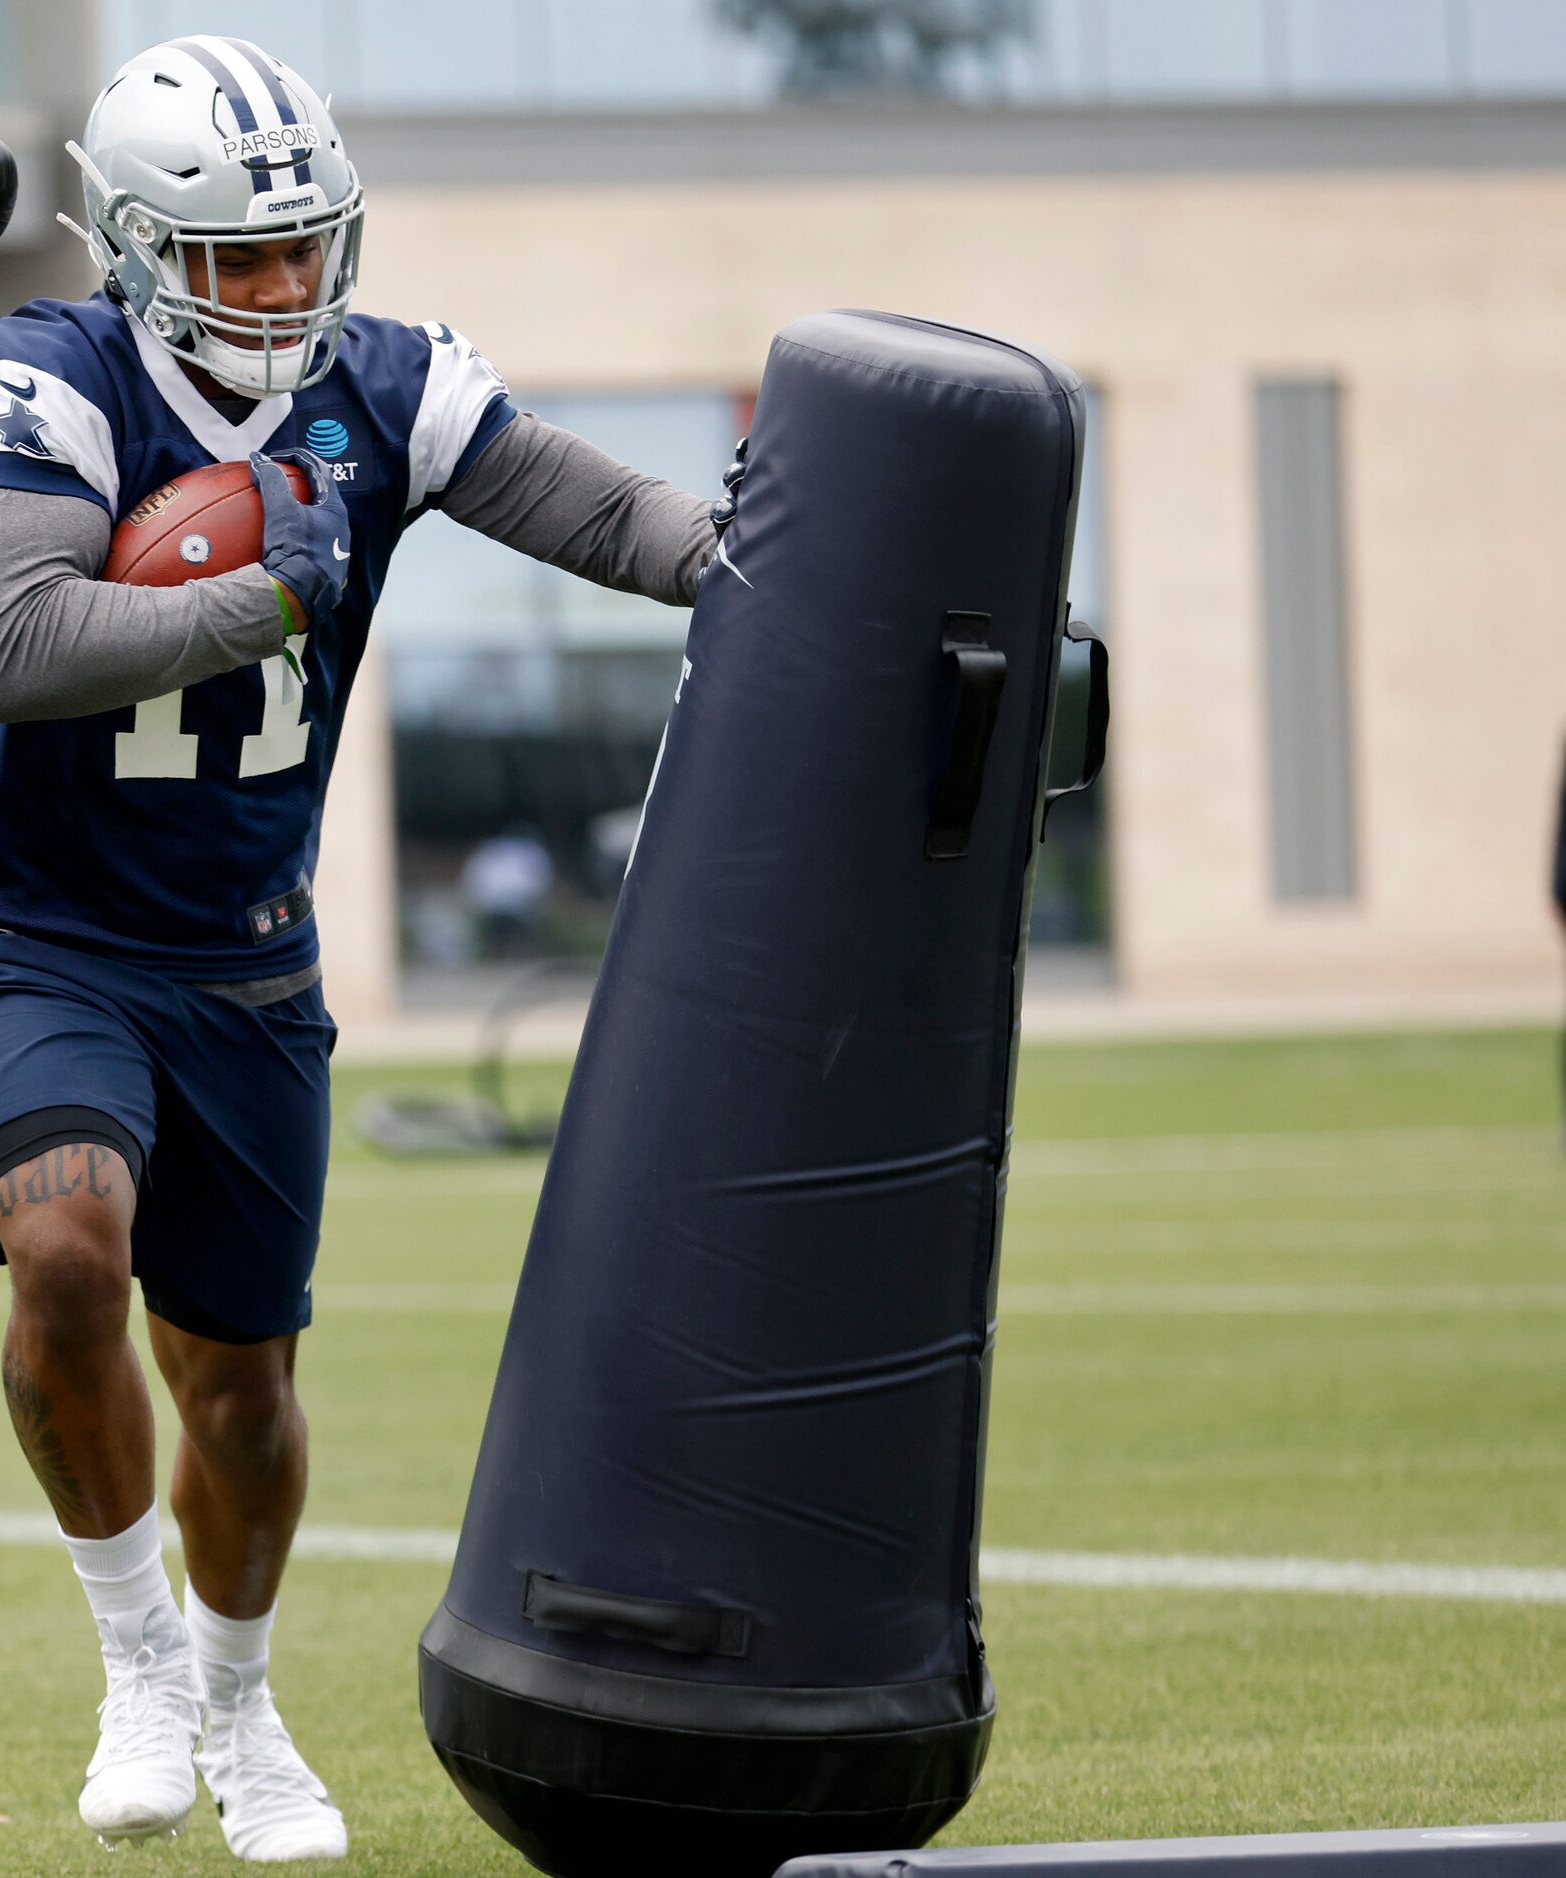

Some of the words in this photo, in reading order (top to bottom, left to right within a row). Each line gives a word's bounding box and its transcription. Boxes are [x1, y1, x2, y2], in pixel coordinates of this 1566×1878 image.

[223, 128, 317, 160] PARSONS
[268, 196, 314, 212] COWBOYS
[129, 485, 176, 522] NFL
